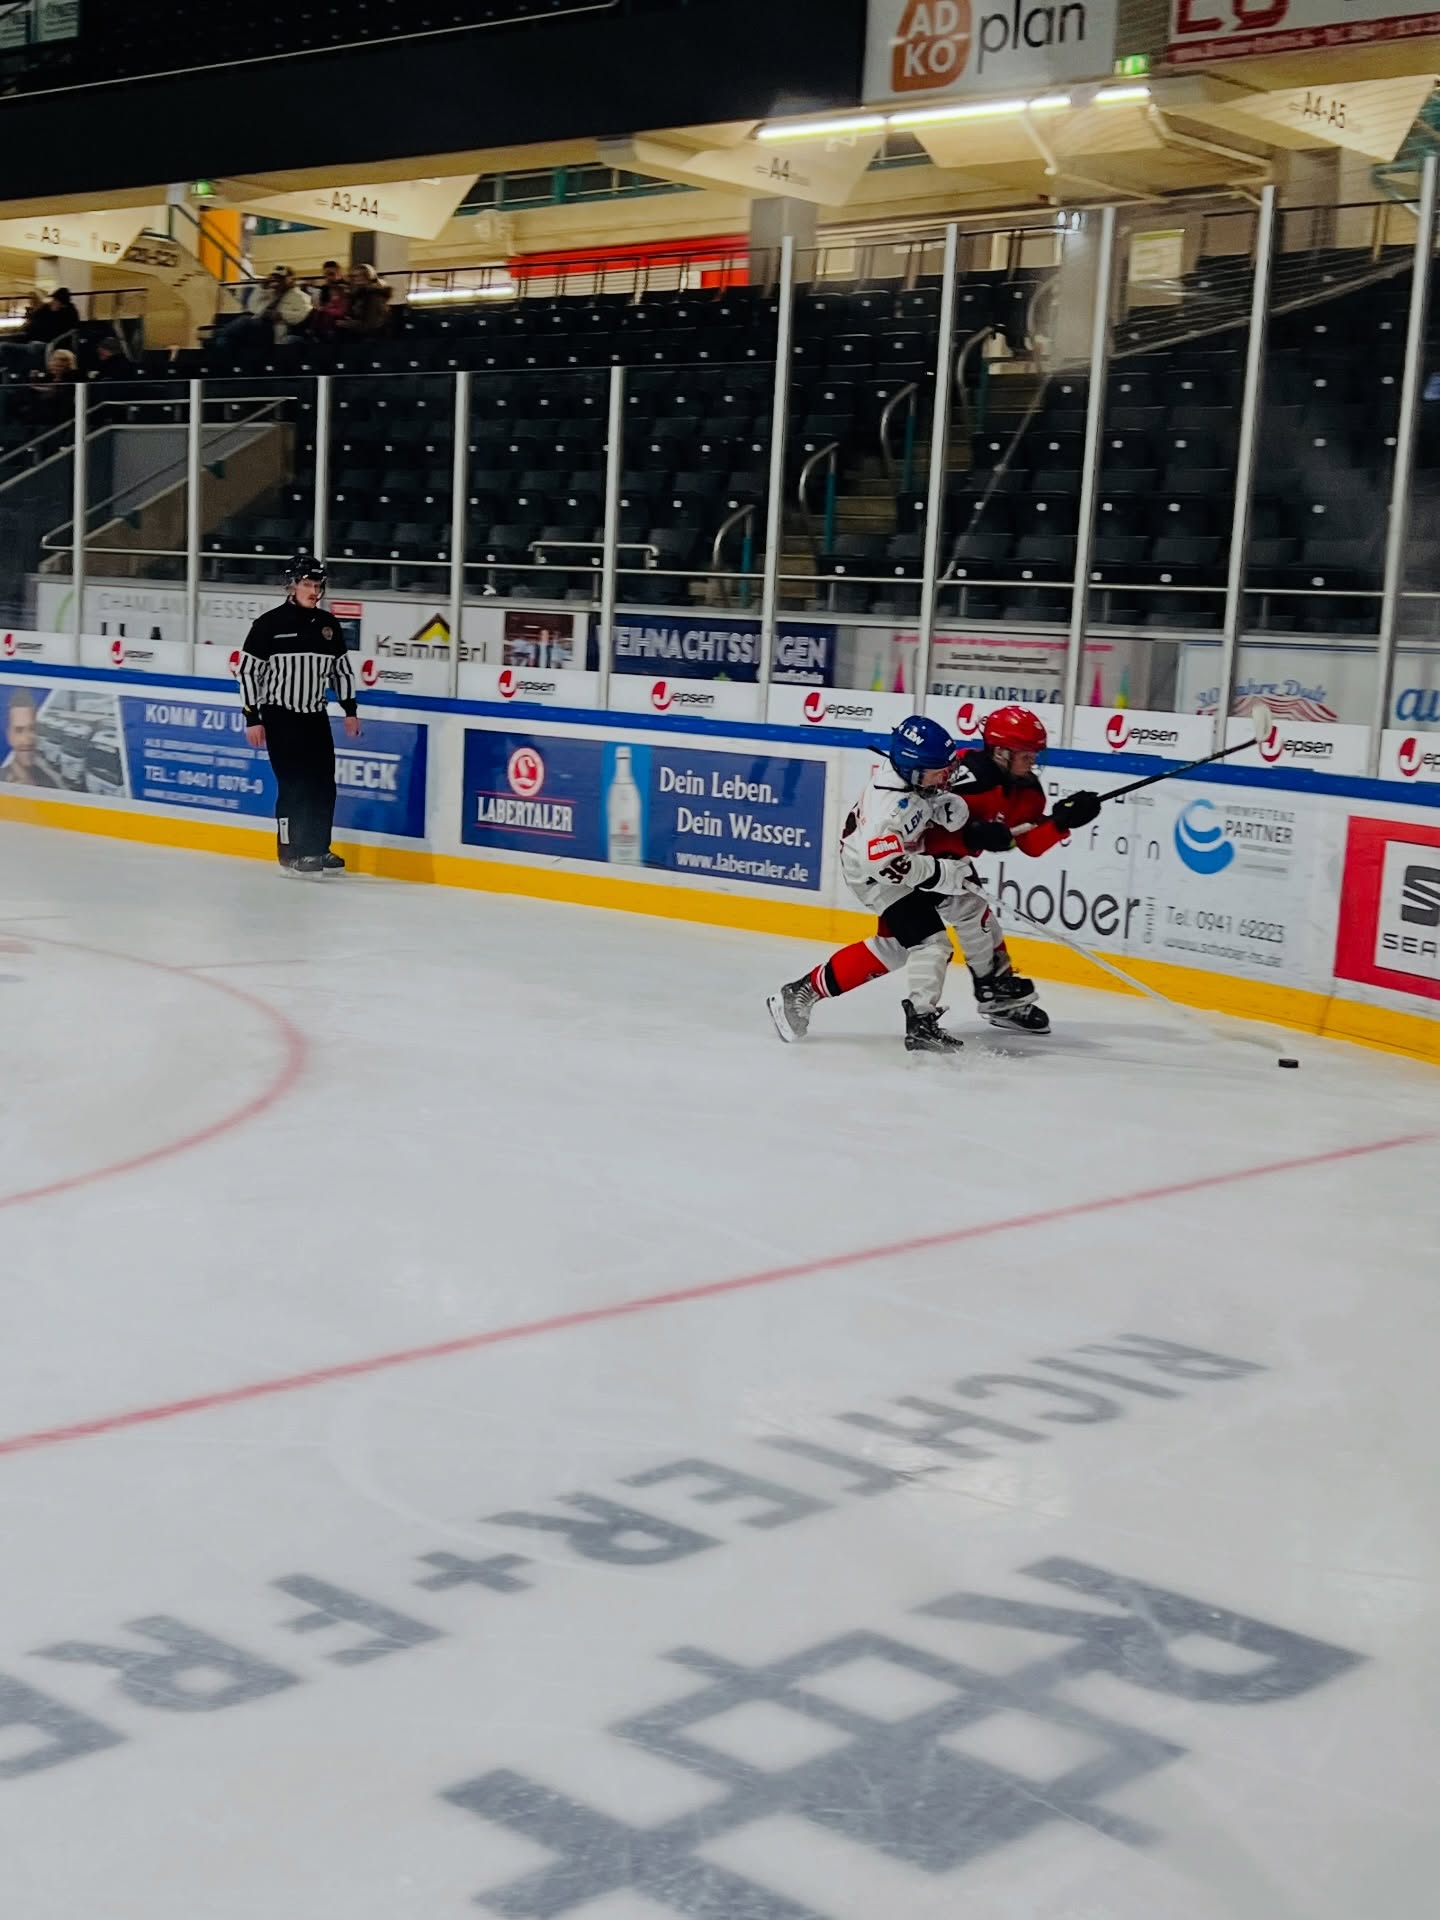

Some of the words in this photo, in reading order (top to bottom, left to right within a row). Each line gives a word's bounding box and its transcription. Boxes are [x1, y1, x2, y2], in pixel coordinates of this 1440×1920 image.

[908, 1, 959, 38] AD
[976, 0, 1085, 74] plan
[904, 39, 957, 77] KO
[769, 157, 790, 181] A4
[329, 190, 379, 218] A3-A4
[40, 226, 61, 246] A3
[144, 703, 198, 727] KOMM
[202, 710, 226, 731] ZU
[230, 712, 246, 733] U
[803, 692, 873, 723] Jepsen
[903, 728, 925, 746] LEW
[1105, 713, 1179, 750] Jepsen
[659, 766, 705, 797] Dein
[710, 772, 779, 805] Leben.
[477, 796, 573, 833] LABERTALER
[676, 807, 722, 838] Dein
[728, 812, 811, 848] Wasser.
[1224, 819, 1293, 844] PARTNER
[675, 852, 809, 882] www.labertaler.de
[979, 861, 1141, 939] hober
